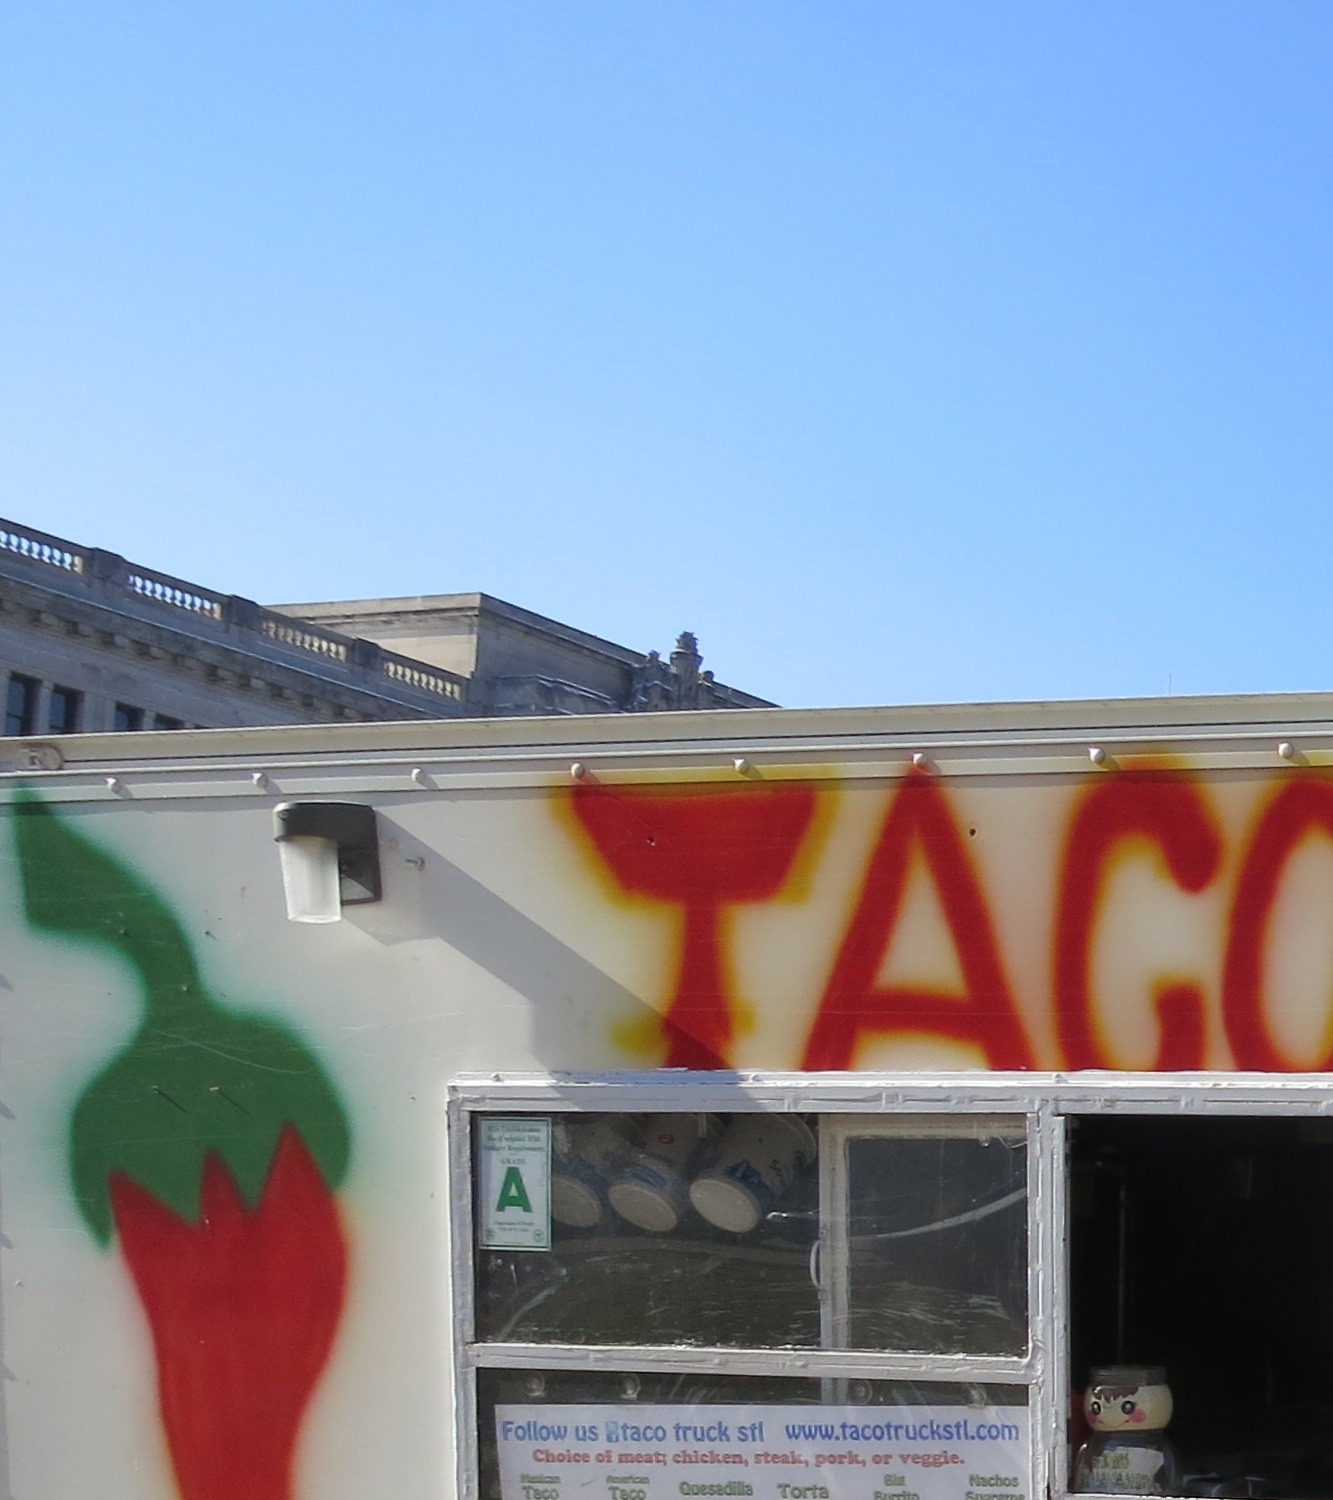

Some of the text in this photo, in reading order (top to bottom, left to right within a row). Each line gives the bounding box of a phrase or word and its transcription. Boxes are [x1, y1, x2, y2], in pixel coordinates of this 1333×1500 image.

[496, 1166, 533, 1213] A
[502, 1421, 568, 1442] Follow
[575, 1424, 599, 1442] us
[675, 1421, 731, 1442] truck
[737, 1420, 765, 1442] stl
[785, 1420, 1020, 1441] www.tacotruckstl.com
[532, 1449, 591, 1464] Choice
[595, 1450, 612, 1464] of
[672, 1450, 749, 1466] chicken,
[754, 1451, 809, 1467] steak,
[814, 1451, 867, 1468] pork,
[871, 1453, 893, 1465] or
[678, 1481, 754, 1496] Quesadilla
[969, 1474, 1020, 1487] Nachos
[522, 1486, 560, 1500] Taco
[608, 1486, 647, 1500] Taco
[776, 1483, 830, 1499] Torta
